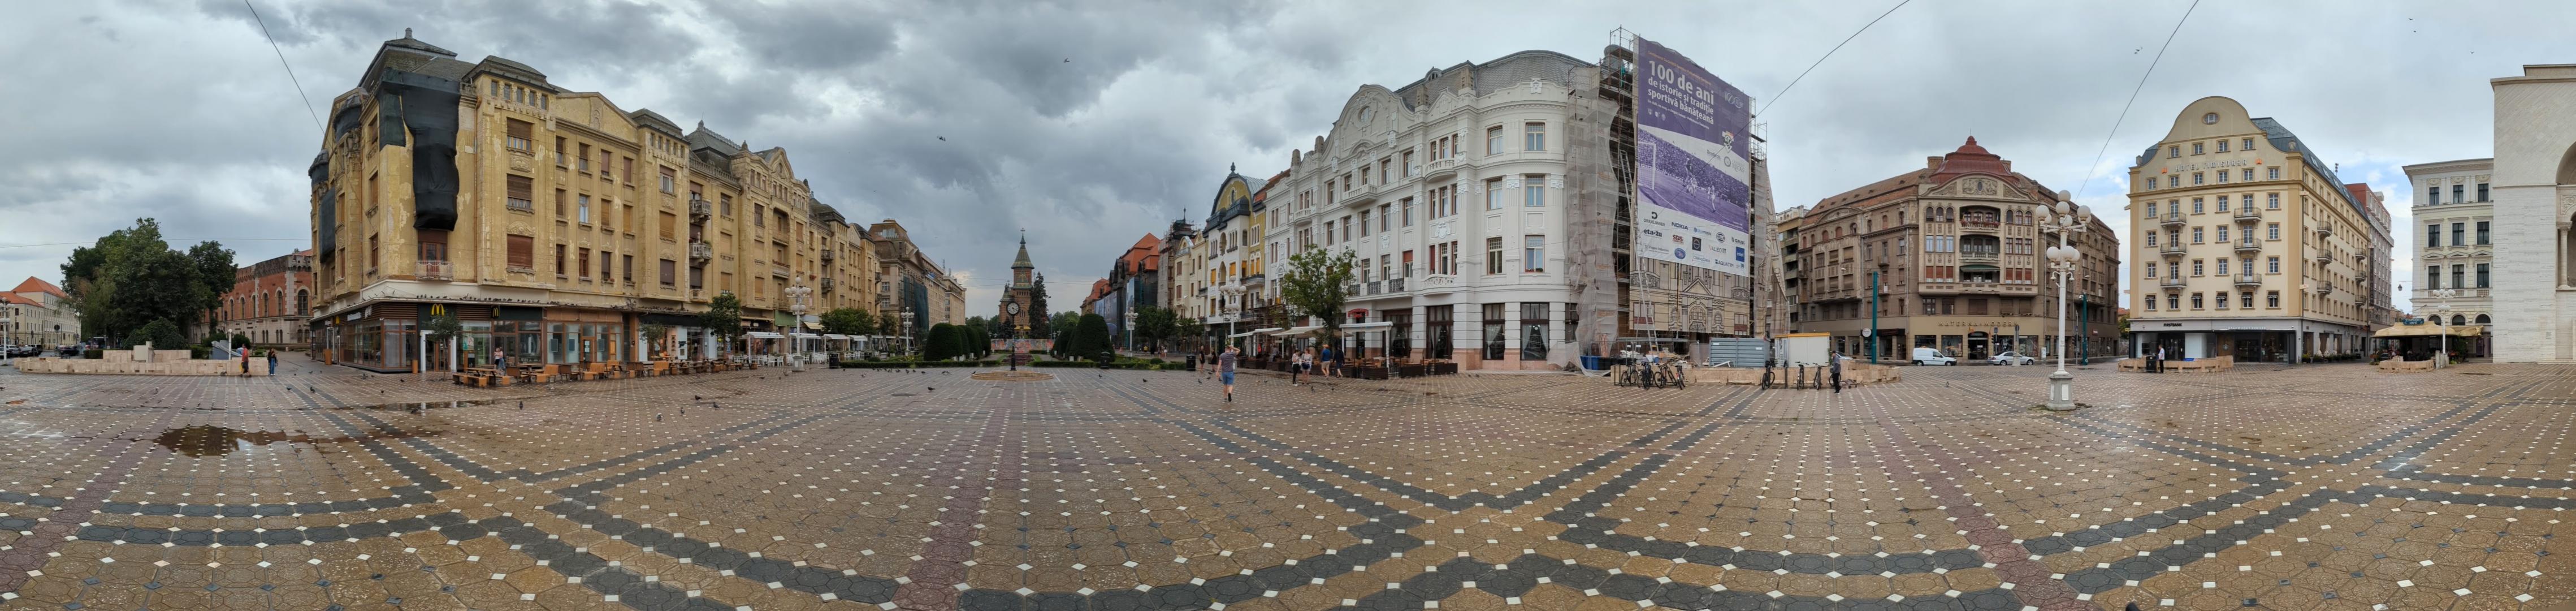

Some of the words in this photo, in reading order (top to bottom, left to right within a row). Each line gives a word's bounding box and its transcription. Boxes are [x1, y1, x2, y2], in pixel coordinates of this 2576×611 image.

[1649, 60, 1674, 84] 100
[1677, 74, 1693, 94] de
[1695, 86, 1714, 105] ani
[1648, 76, 1658, 88] de
[1659, 80, 1682, 99] istorie
[1690, 96, 1714, 115] tradiție
[1648, 88, 1678, 108] sportivă
[1679, 100, 1714, 124] bănățeană
[2176, 162, 2199, 172] HOTEL
[1643, 229, 1663, 237] eta-2u
[1671, 221, 1689, 230] NOKIA
